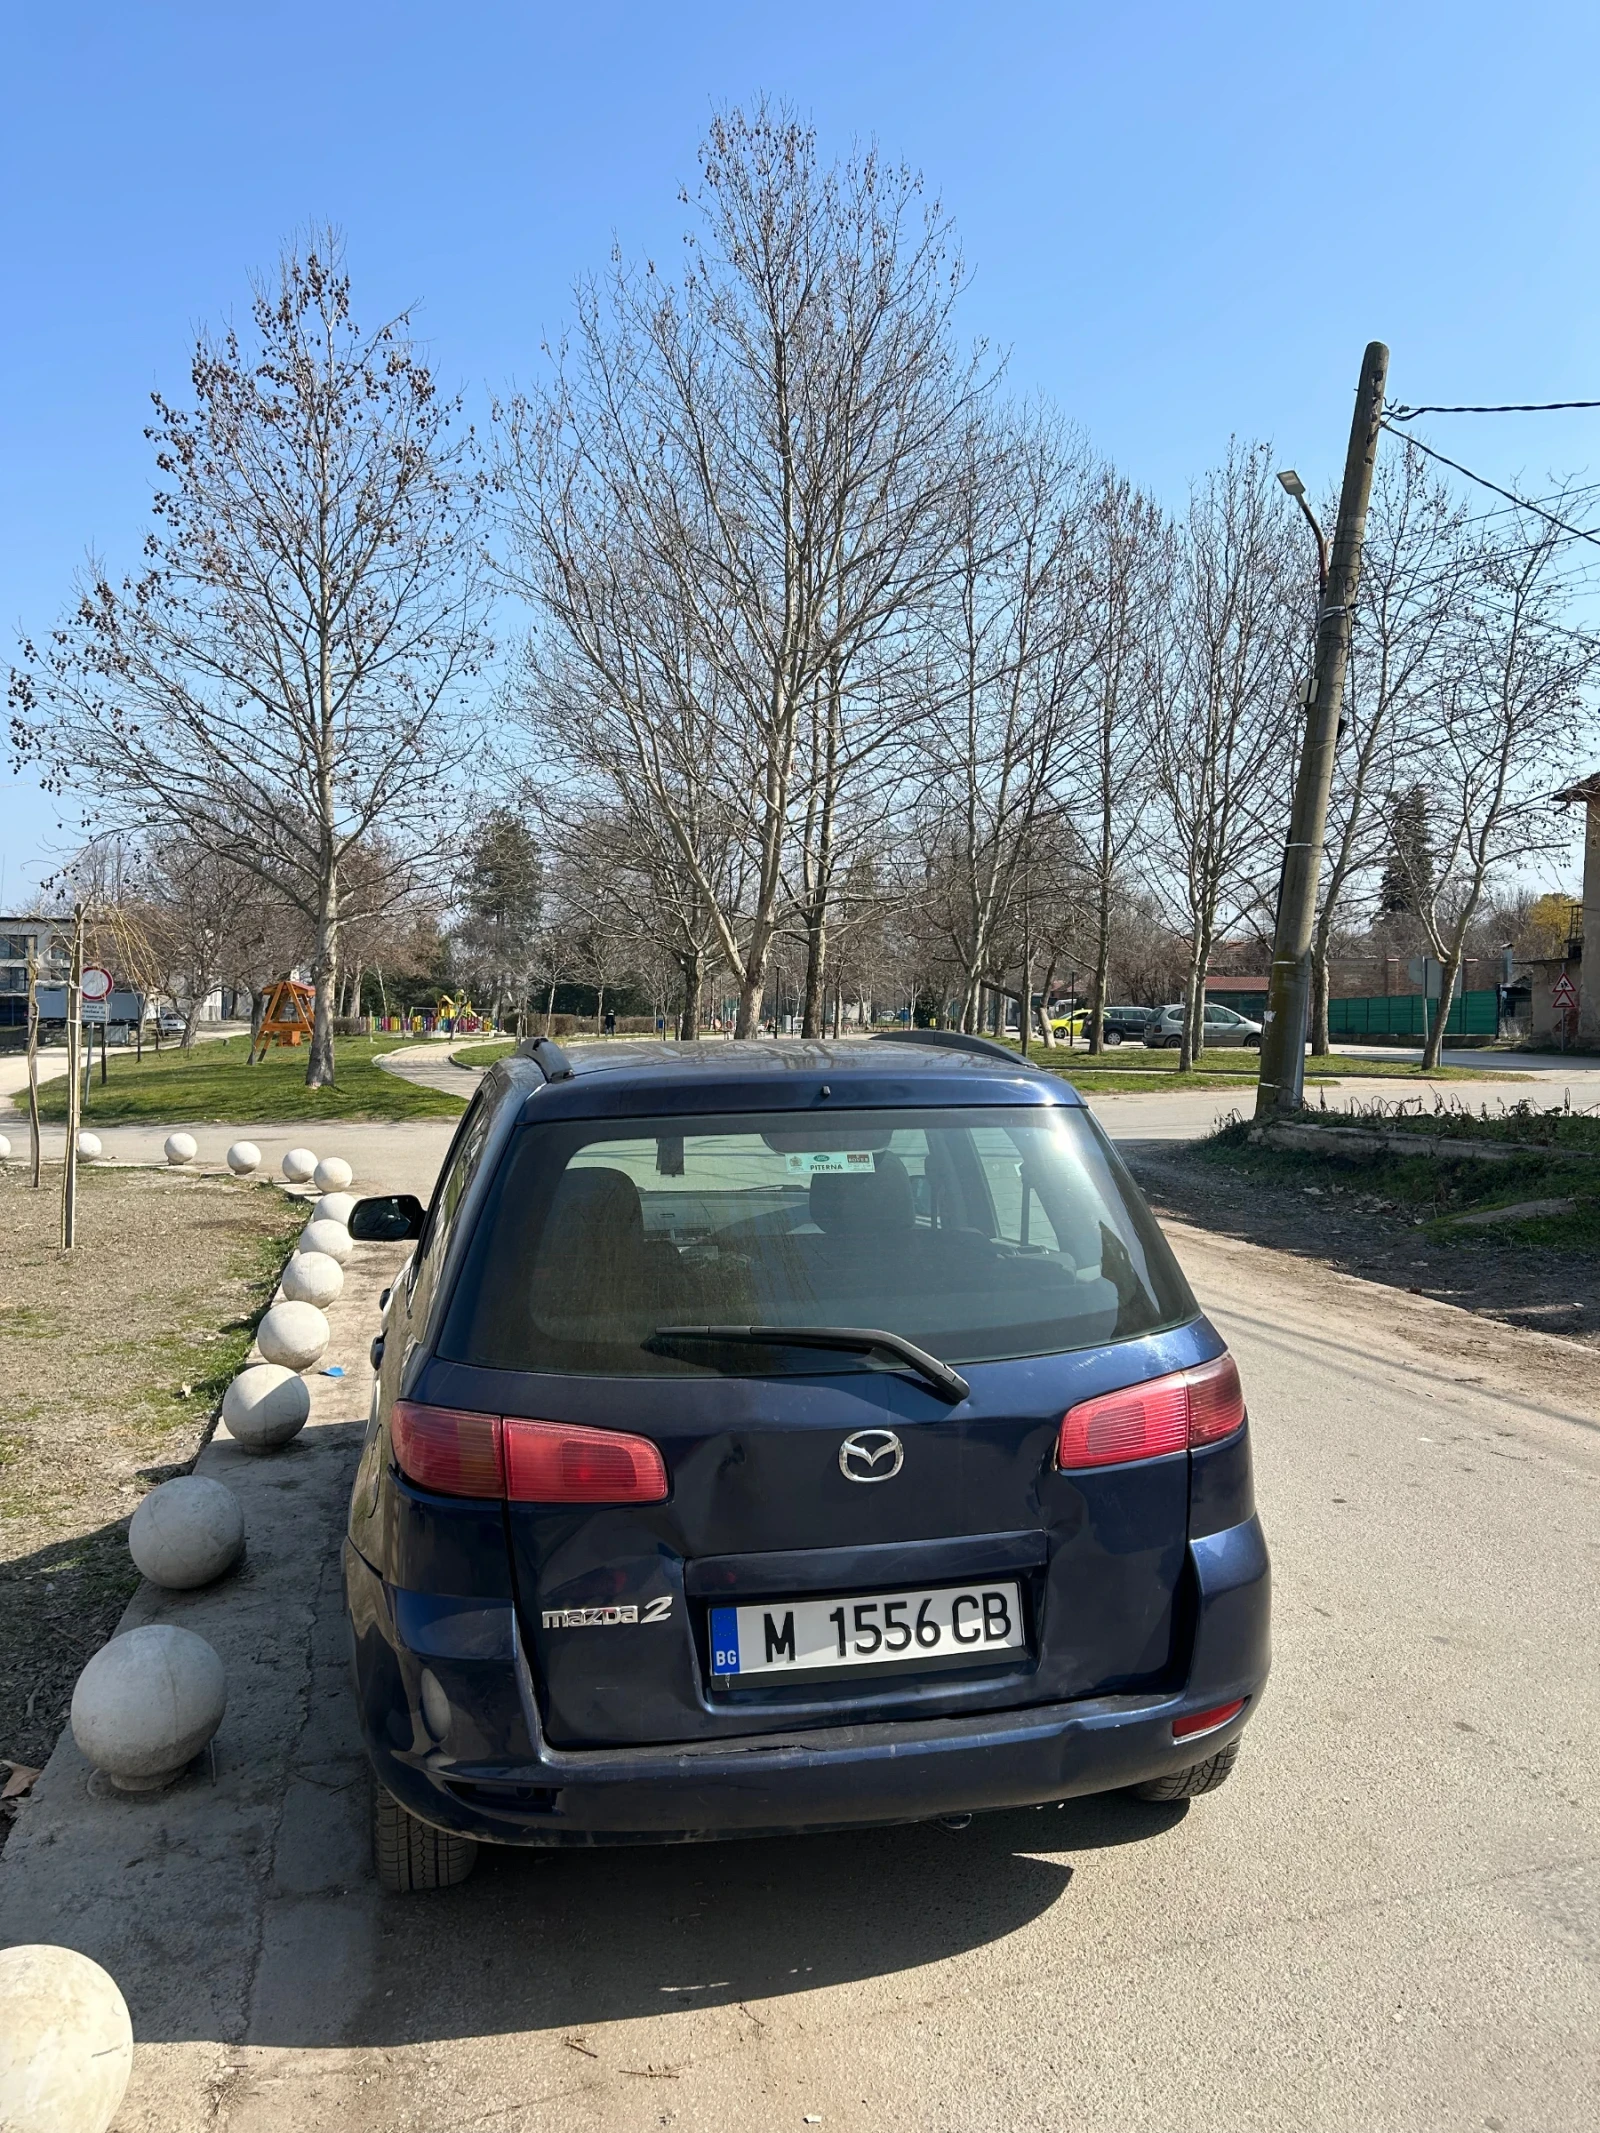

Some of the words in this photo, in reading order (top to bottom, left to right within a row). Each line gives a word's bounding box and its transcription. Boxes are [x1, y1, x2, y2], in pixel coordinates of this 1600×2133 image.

[640, 1596, 673, 1624] 2
[763, 1611, 796, 1663] M
[829, 1598, 941, 1657] 1556
[951, 1592, 1012, 1644] CB
[716, 1650, 737, 1666] BG
